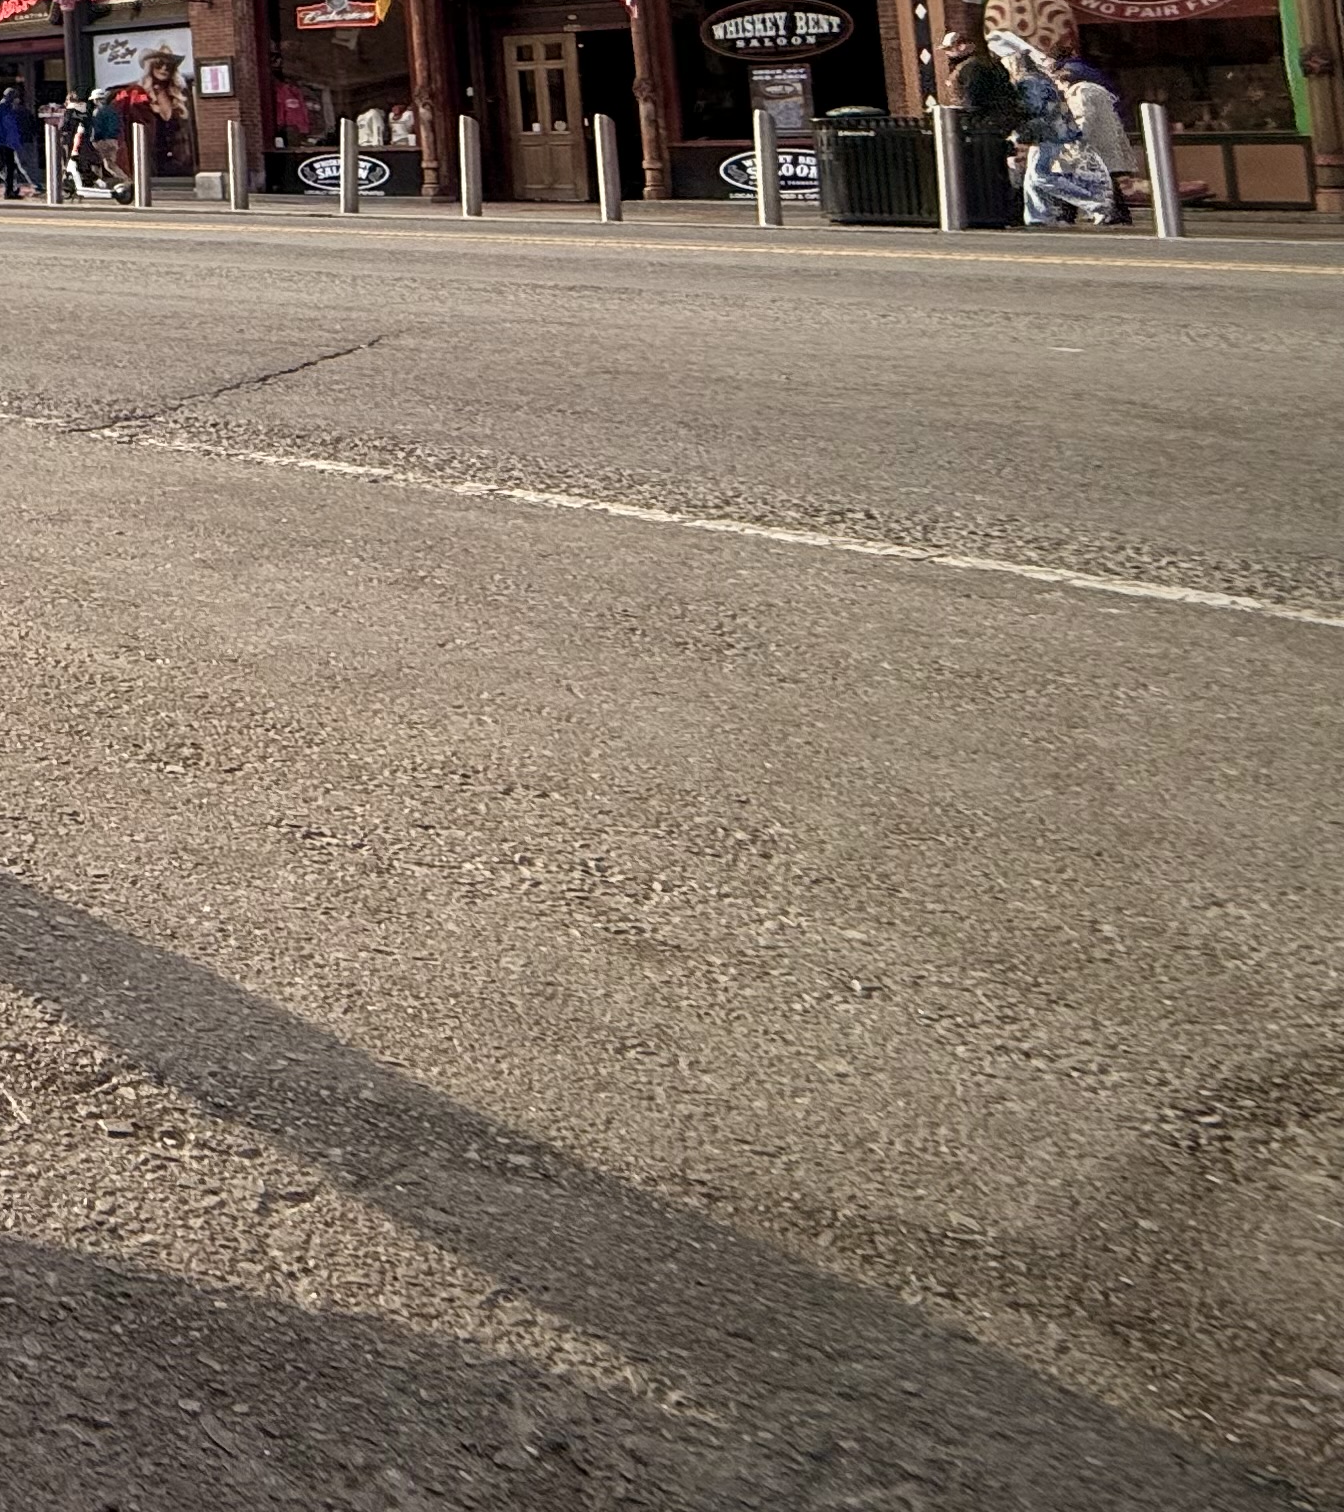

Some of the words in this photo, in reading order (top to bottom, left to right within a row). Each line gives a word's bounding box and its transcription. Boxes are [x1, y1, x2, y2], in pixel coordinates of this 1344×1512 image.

[1124, 5, 1180, 18] PAIR
[712, 11, 788, 40] WHISKEY
[793, 11, 842, 35] BENT
[735, 35, 817, 48] SALOON
